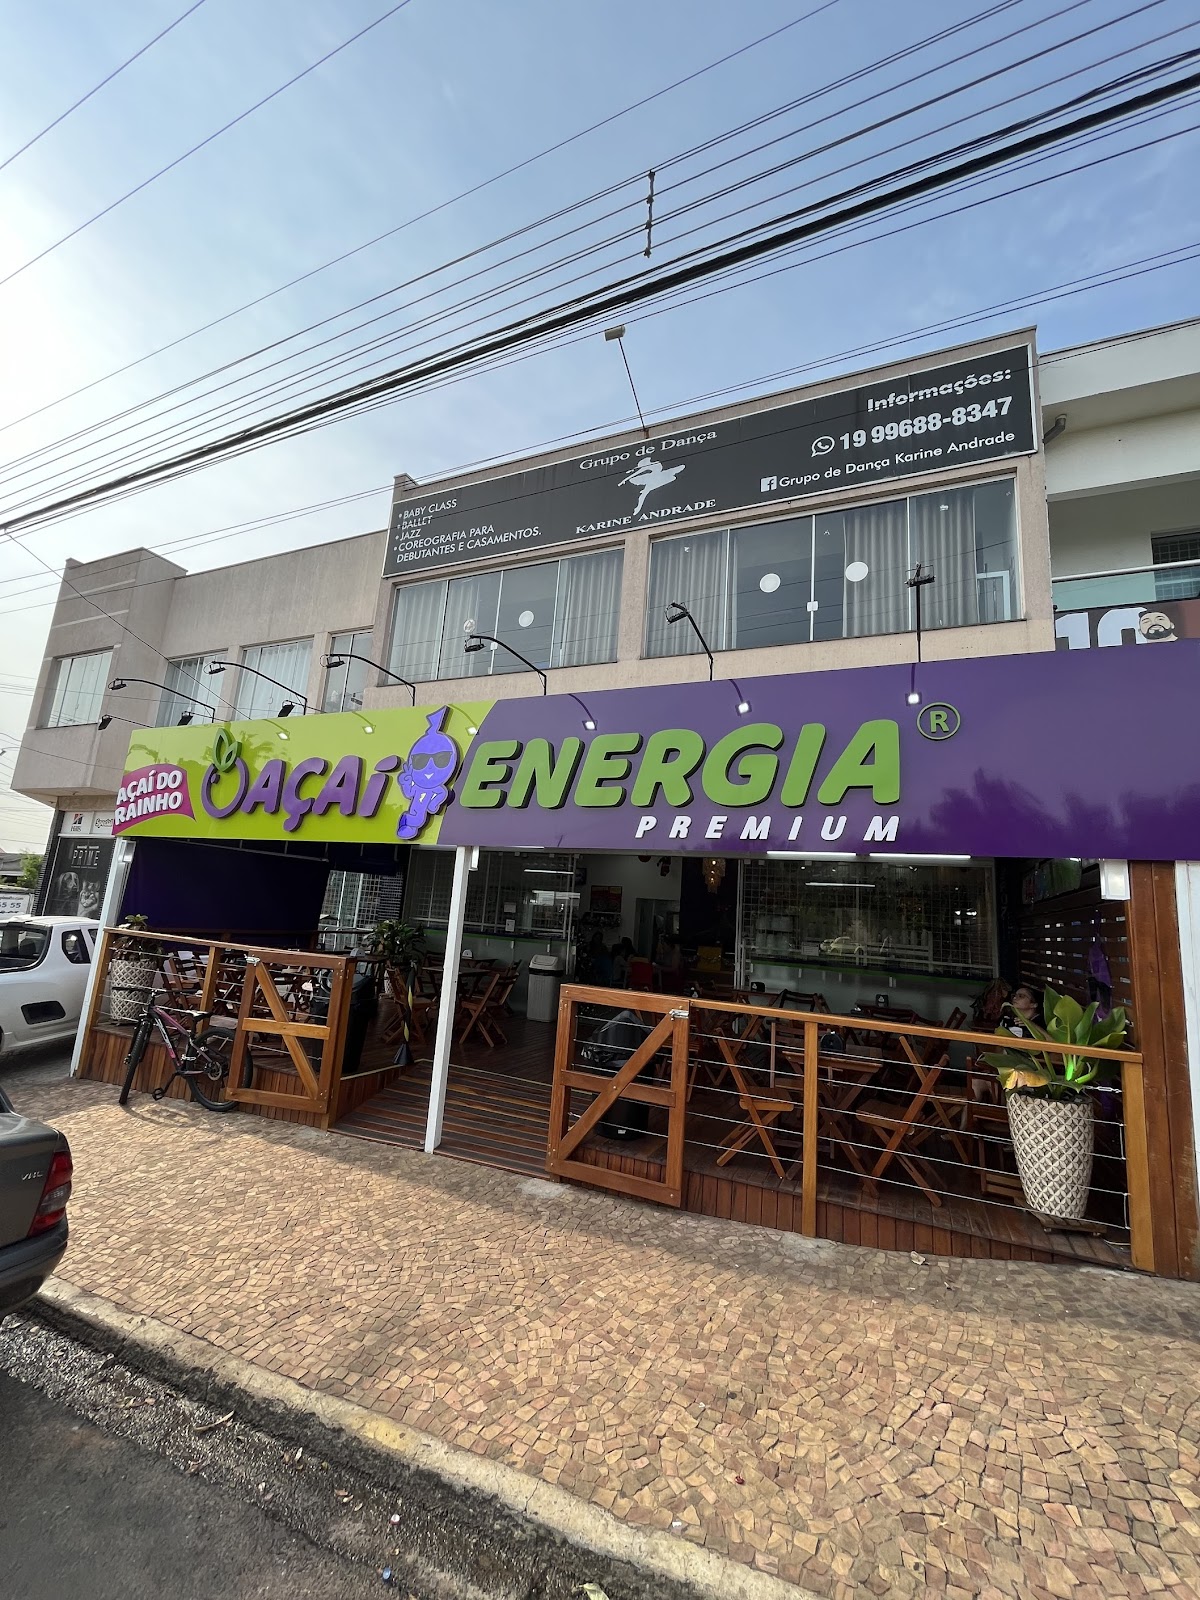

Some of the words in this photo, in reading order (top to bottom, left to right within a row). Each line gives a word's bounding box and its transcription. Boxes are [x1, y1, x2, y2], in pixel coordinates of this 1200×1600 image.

[867, 368, 1012, 413] Informações:
[839, 429, 867, 450] 19
[871, 396, 1013, 444] 99688-8347
[579, 452, 631, 470] Grupo
[635, 445, 655, 457] de
[660, 431, 717, 451] Dança
[779, 471, 821, 488] Grupo
[824, 466, 841, 479] de
[845, 456, 890, 475] Dança
[895, 446, 942, 465] Karine
[947, 431, 1015, 454] Andrade
[401, 515, 433, 530] BALLET
[403, 506, 426, 520] BABY
[428, 499, 457, 513] CLASS
[575, 516, 632, 534] KARINE
[637, 499, 717, 522] ANDRADE
[396, 542, 456, 563] DEBUTANTES
[458, 541, 465, 551] E
[466, 526, 542, 550] CASAMENTOS.
[398, 530, 467, 552] COREOGRAFIA
[469, 524, 495, 538] PARA
[399, 528, 422, 541] JAZZ
[459, 719, 901, 810] ENERGIA
[116, 771, 159, 804] AÇAÍ
[157, 770, 184, 791] DO
[113, 790, 184, 826] RAINHO
[635, 815, 900, 842] PREMIUM
